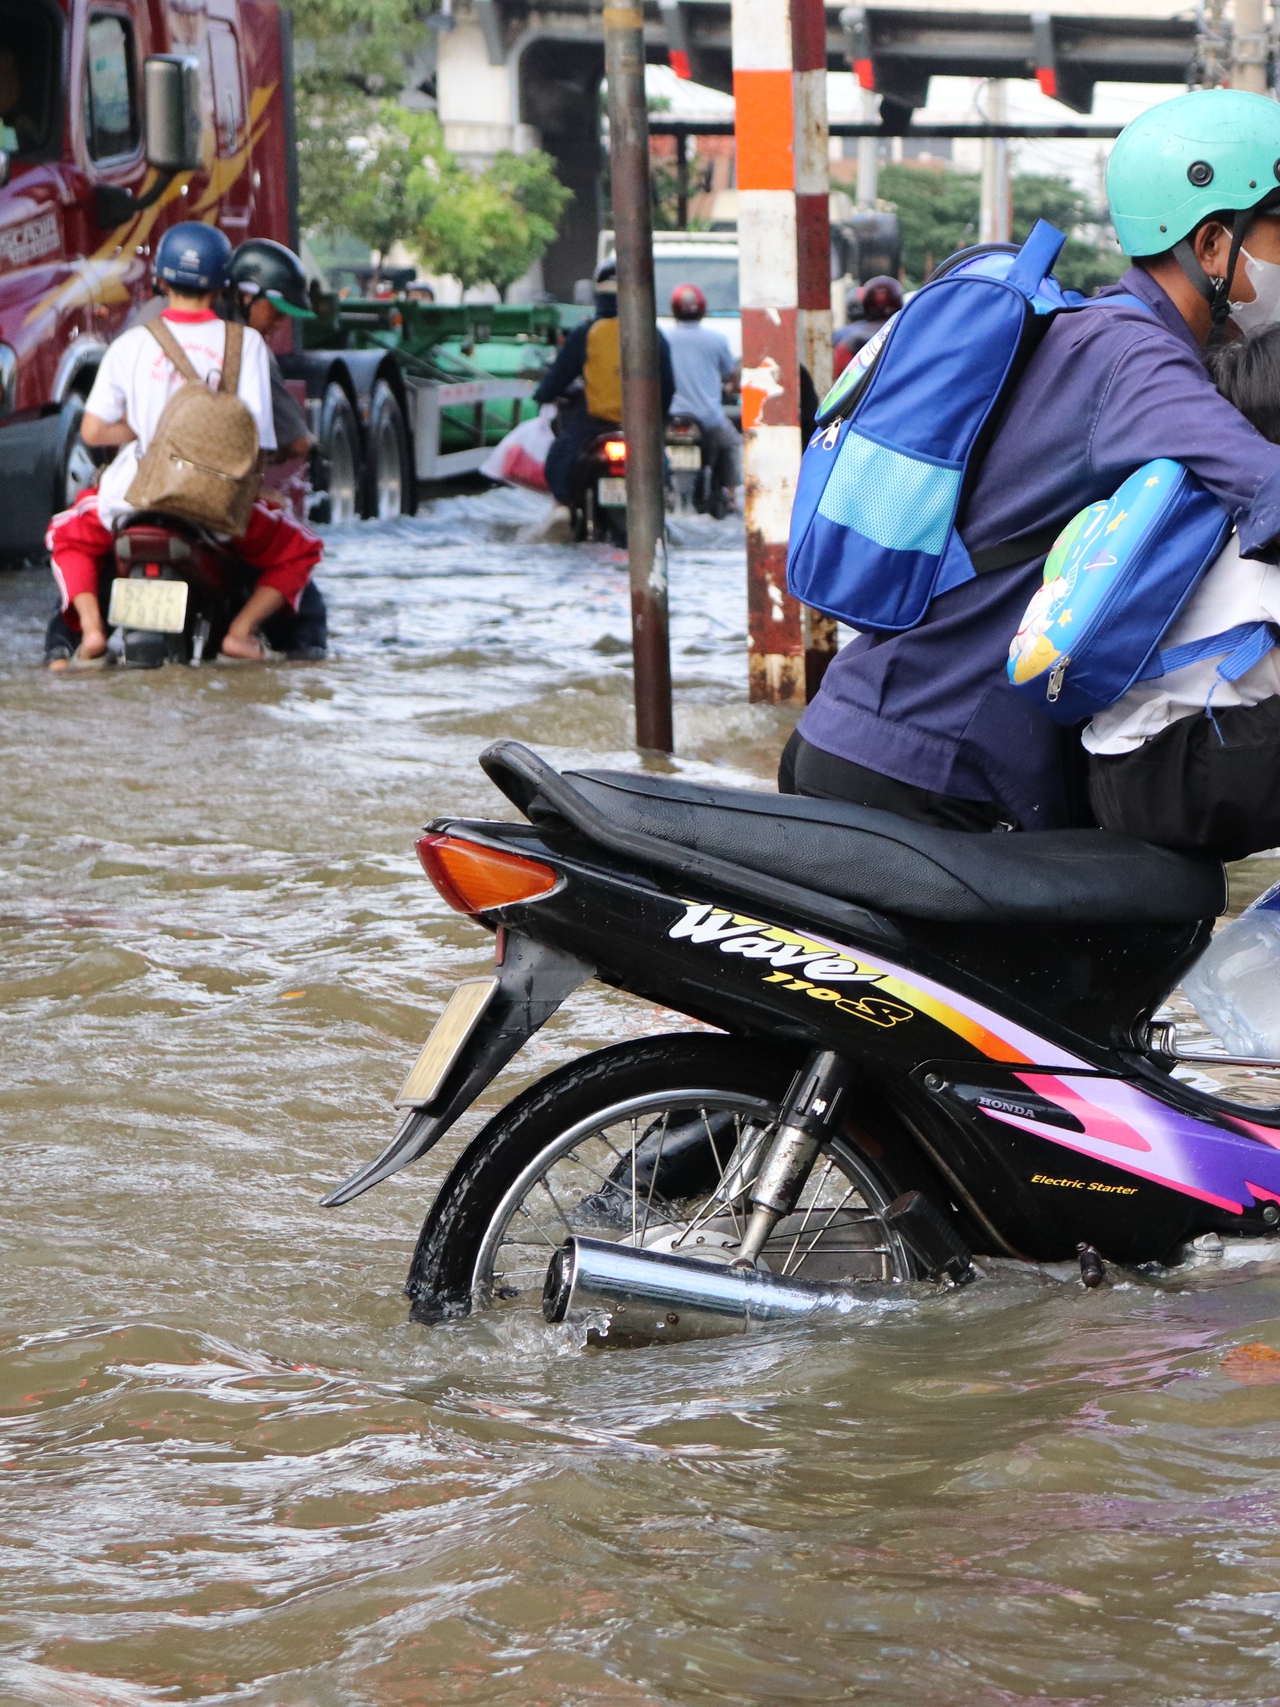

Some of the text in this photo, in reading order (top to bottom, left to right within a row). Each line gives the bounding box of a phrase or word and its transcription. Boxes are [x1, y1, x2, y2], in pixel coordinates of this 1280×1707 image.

[668, 903, 889, 983] Wave
[978, 1096, 1036, 1119] HONDA
[1030, 1173, 1139, 1196] Electric Starter
